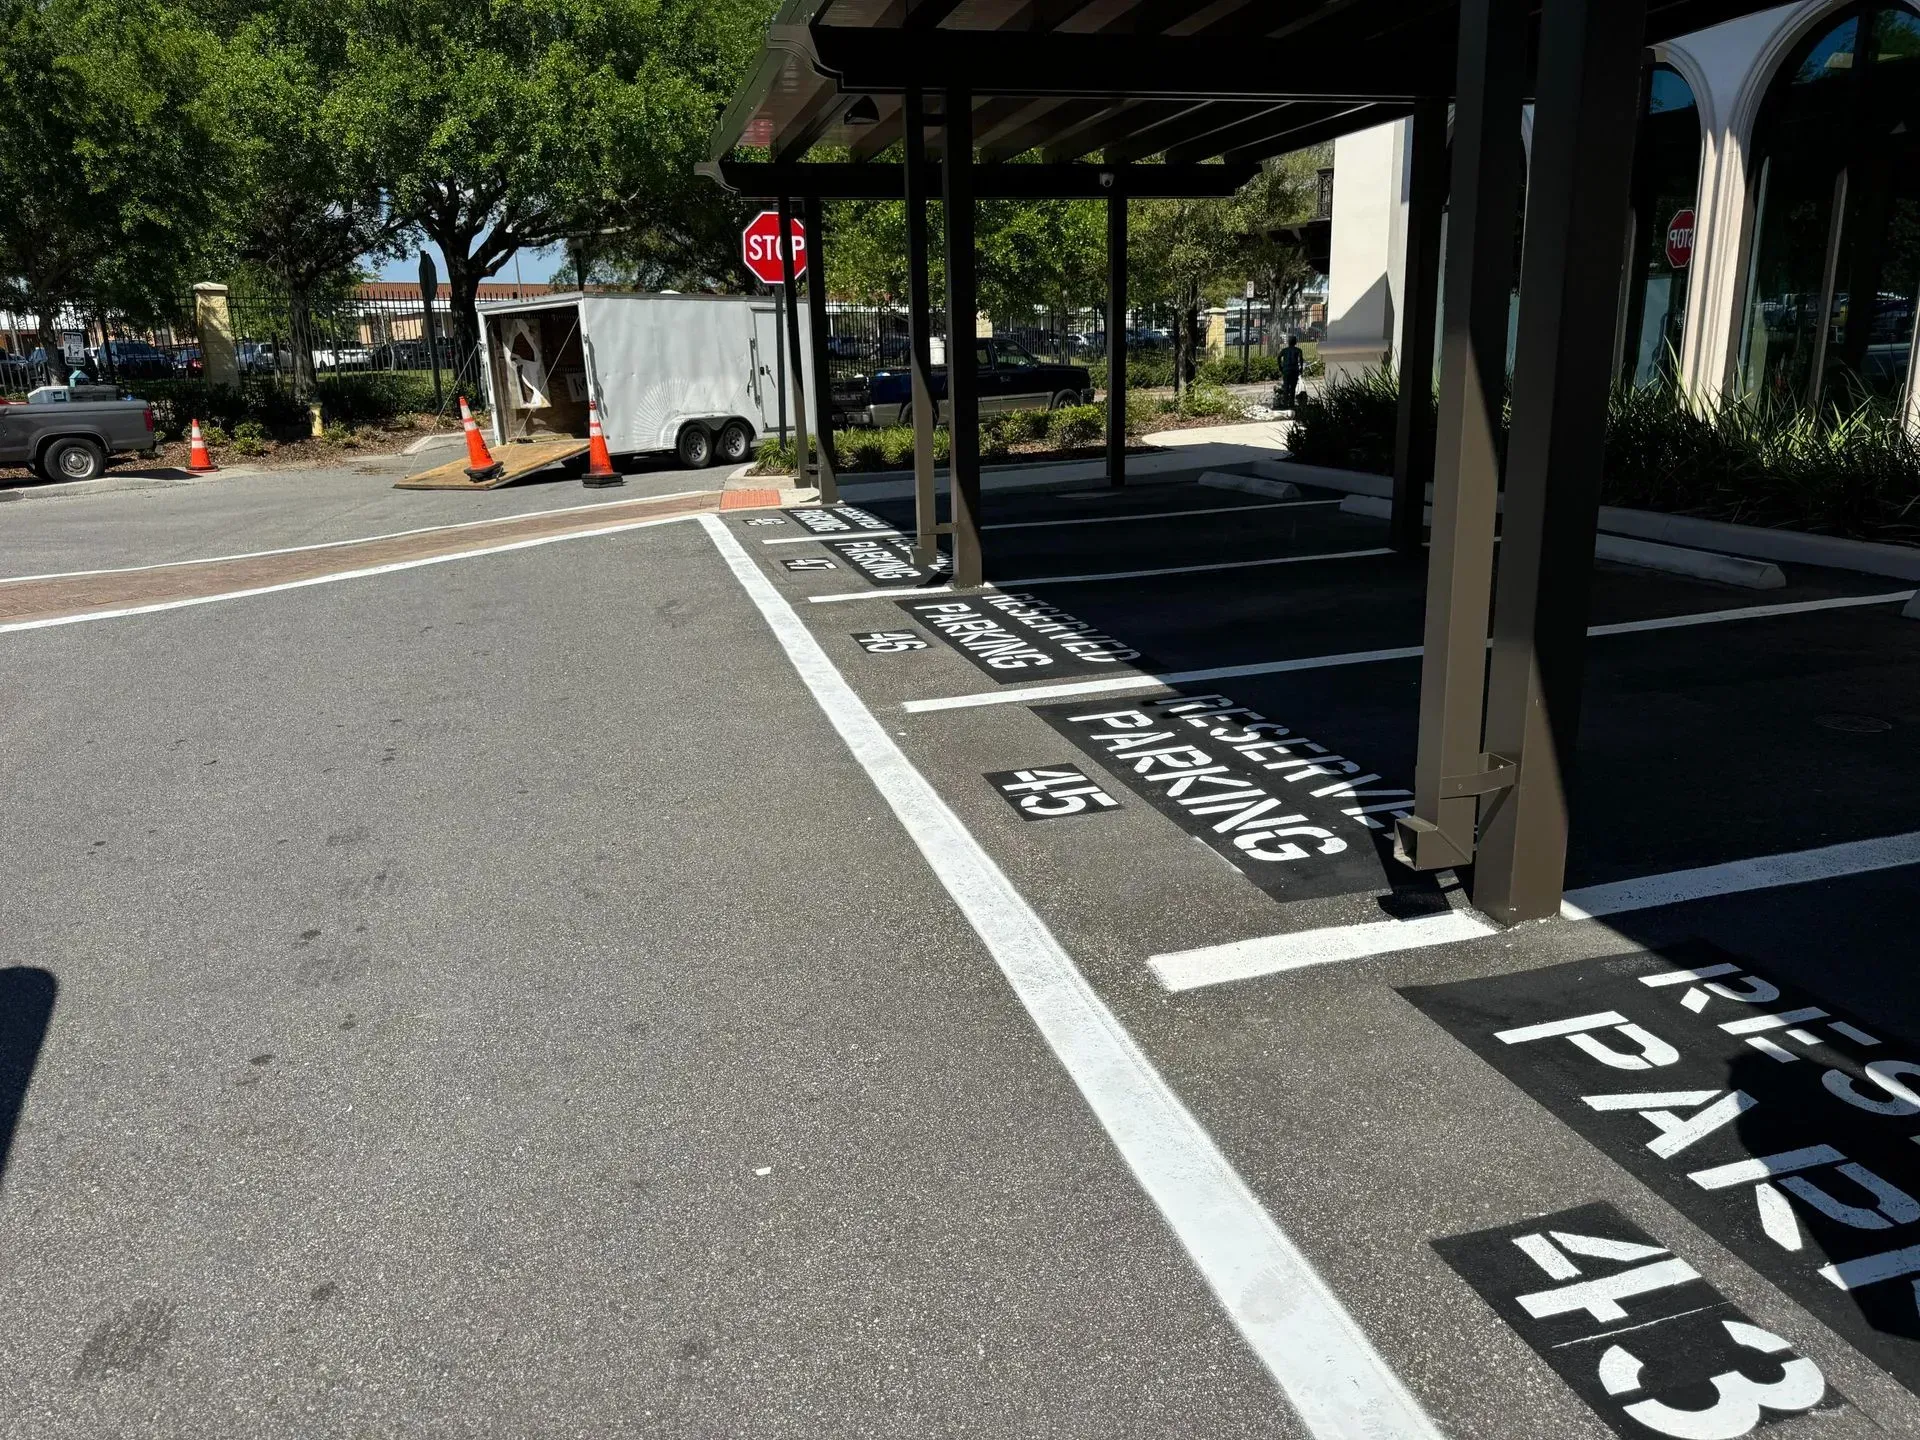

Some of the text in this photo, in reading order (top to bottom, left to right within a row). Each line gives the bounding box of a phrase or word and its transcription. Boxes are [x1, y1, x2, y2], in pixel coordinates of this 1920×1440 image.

[787, 558, 837, 570] 47
[834, 541, 921, 579] PARKING
[858, 633, 928, 653] 46
[914, 603, 1053, 669] PARKING
[982, 593, 1142, 663] RESERVED
[1002, 770, 1118, 816] 45
[1067, 710, 1348, 862] PARKING
[1154, 694, 1416, 841] RESERVE
[1512, 1231, 1825, 1440] 43
